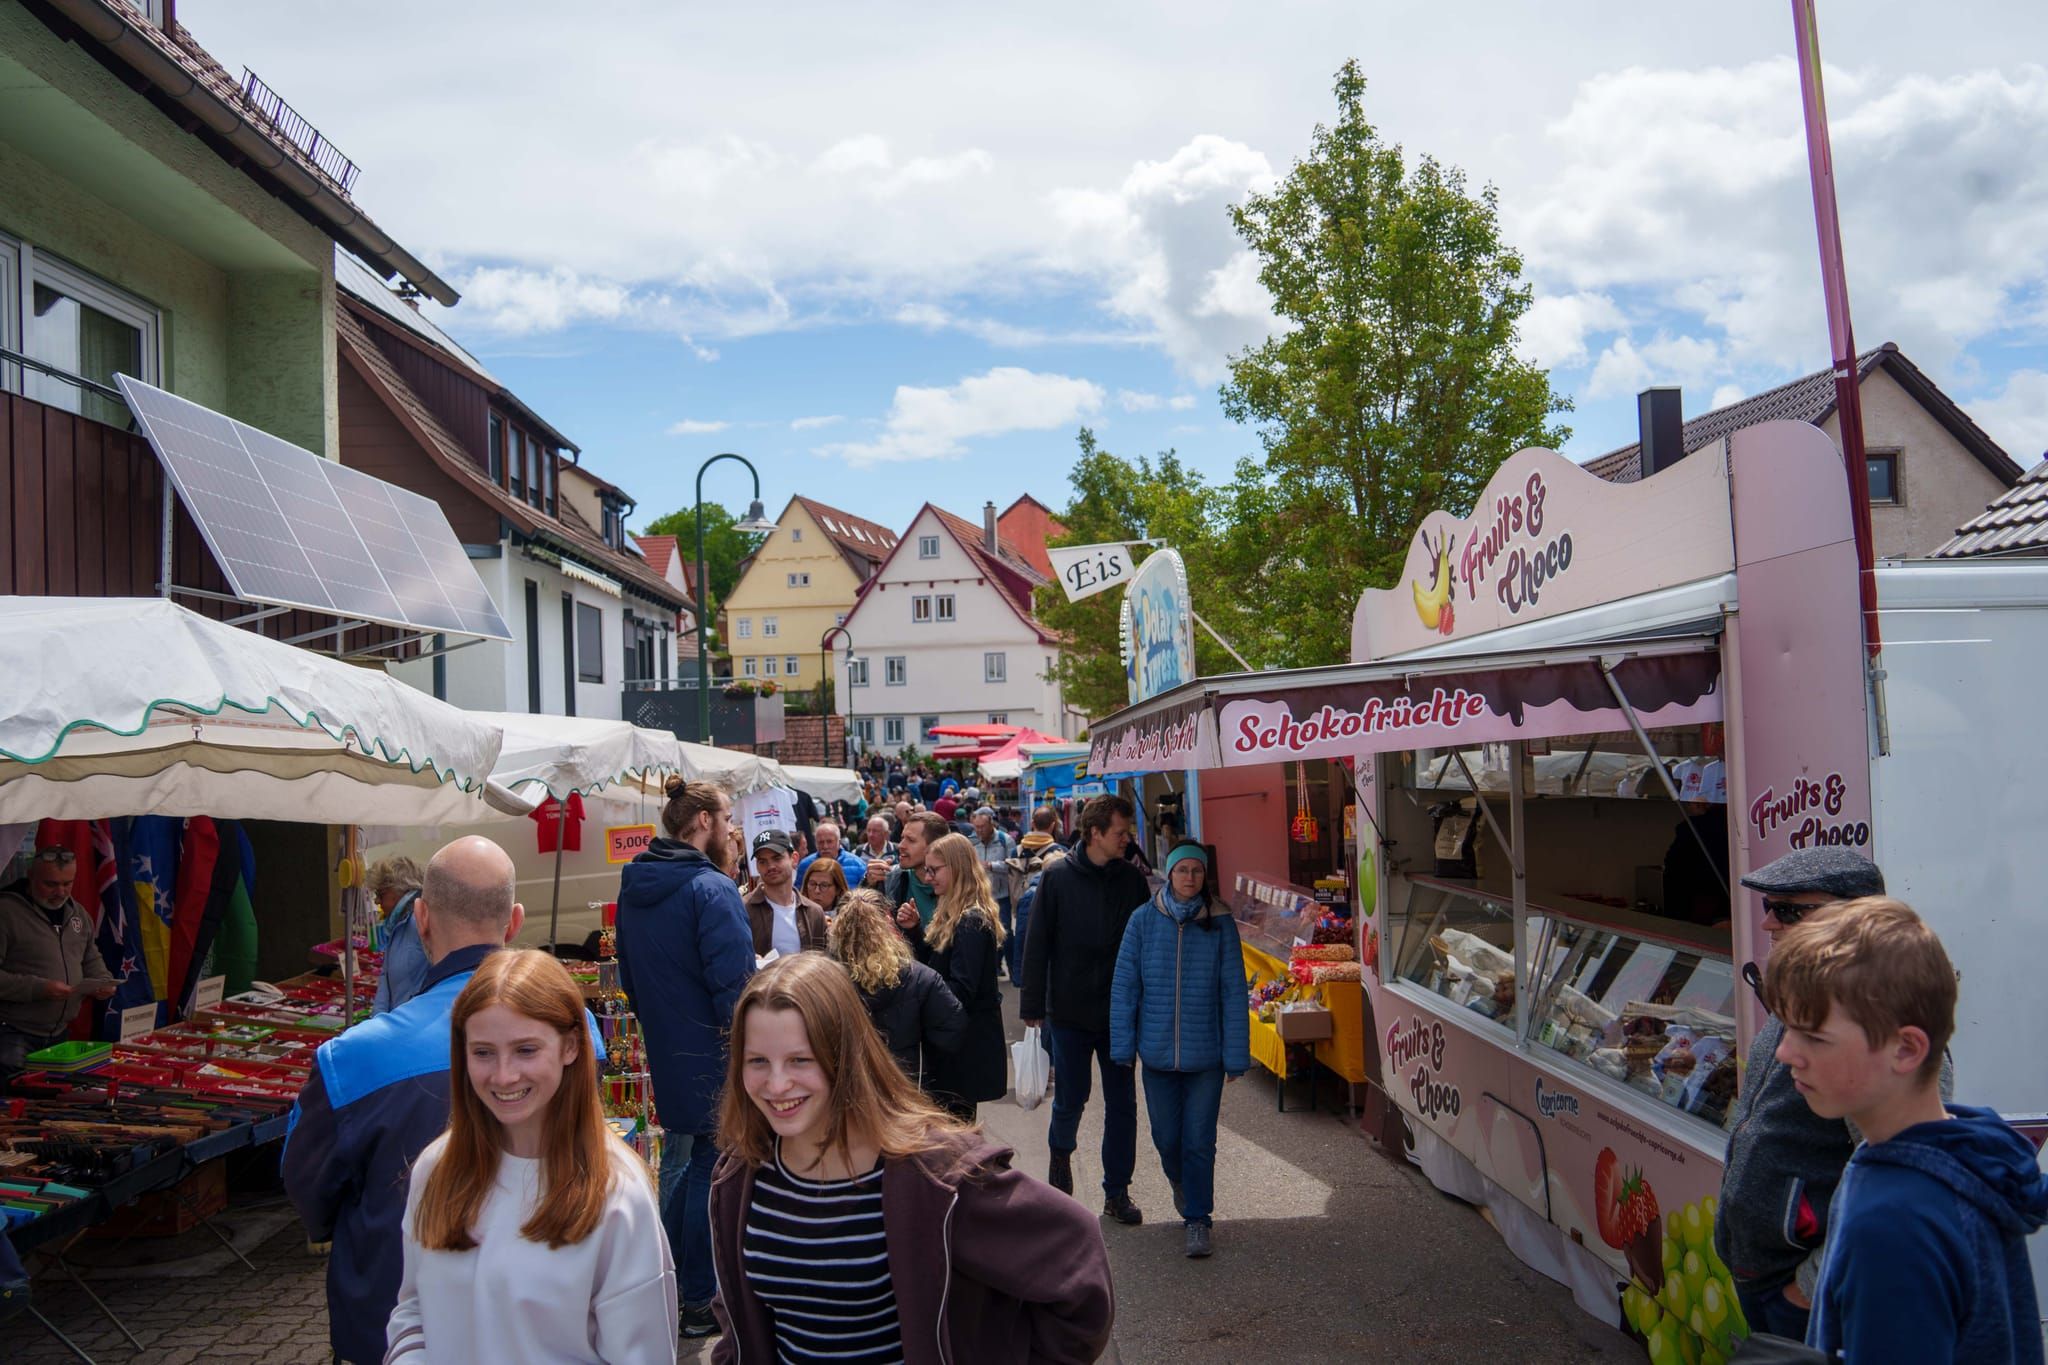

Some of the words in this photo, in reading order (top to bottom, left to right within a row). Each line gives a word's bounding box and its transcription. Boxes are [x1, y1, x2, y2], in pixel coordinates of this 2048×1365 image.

[1461, 495, 1522, 600] Fruits
[1526, 472, 1546, 537] &
[1066, 552, 1122, 591] Eis
[1498, 533, 1573, 614] Choco
[1235, 689, 1485, 752] Schokofrüchte
[1750, 778, 1821, 839] Fruits
[1824, 774, 1846, 816] &
[615, 835, 650, 851] 5,00€
[1387, 1016, 1430, 1075] Fruits
[1431, 1022, 1445, 1072] &
[1410, 1066, 1460, 1121] Choco
[1535, 1077, 1579, 1118] Capricorne
